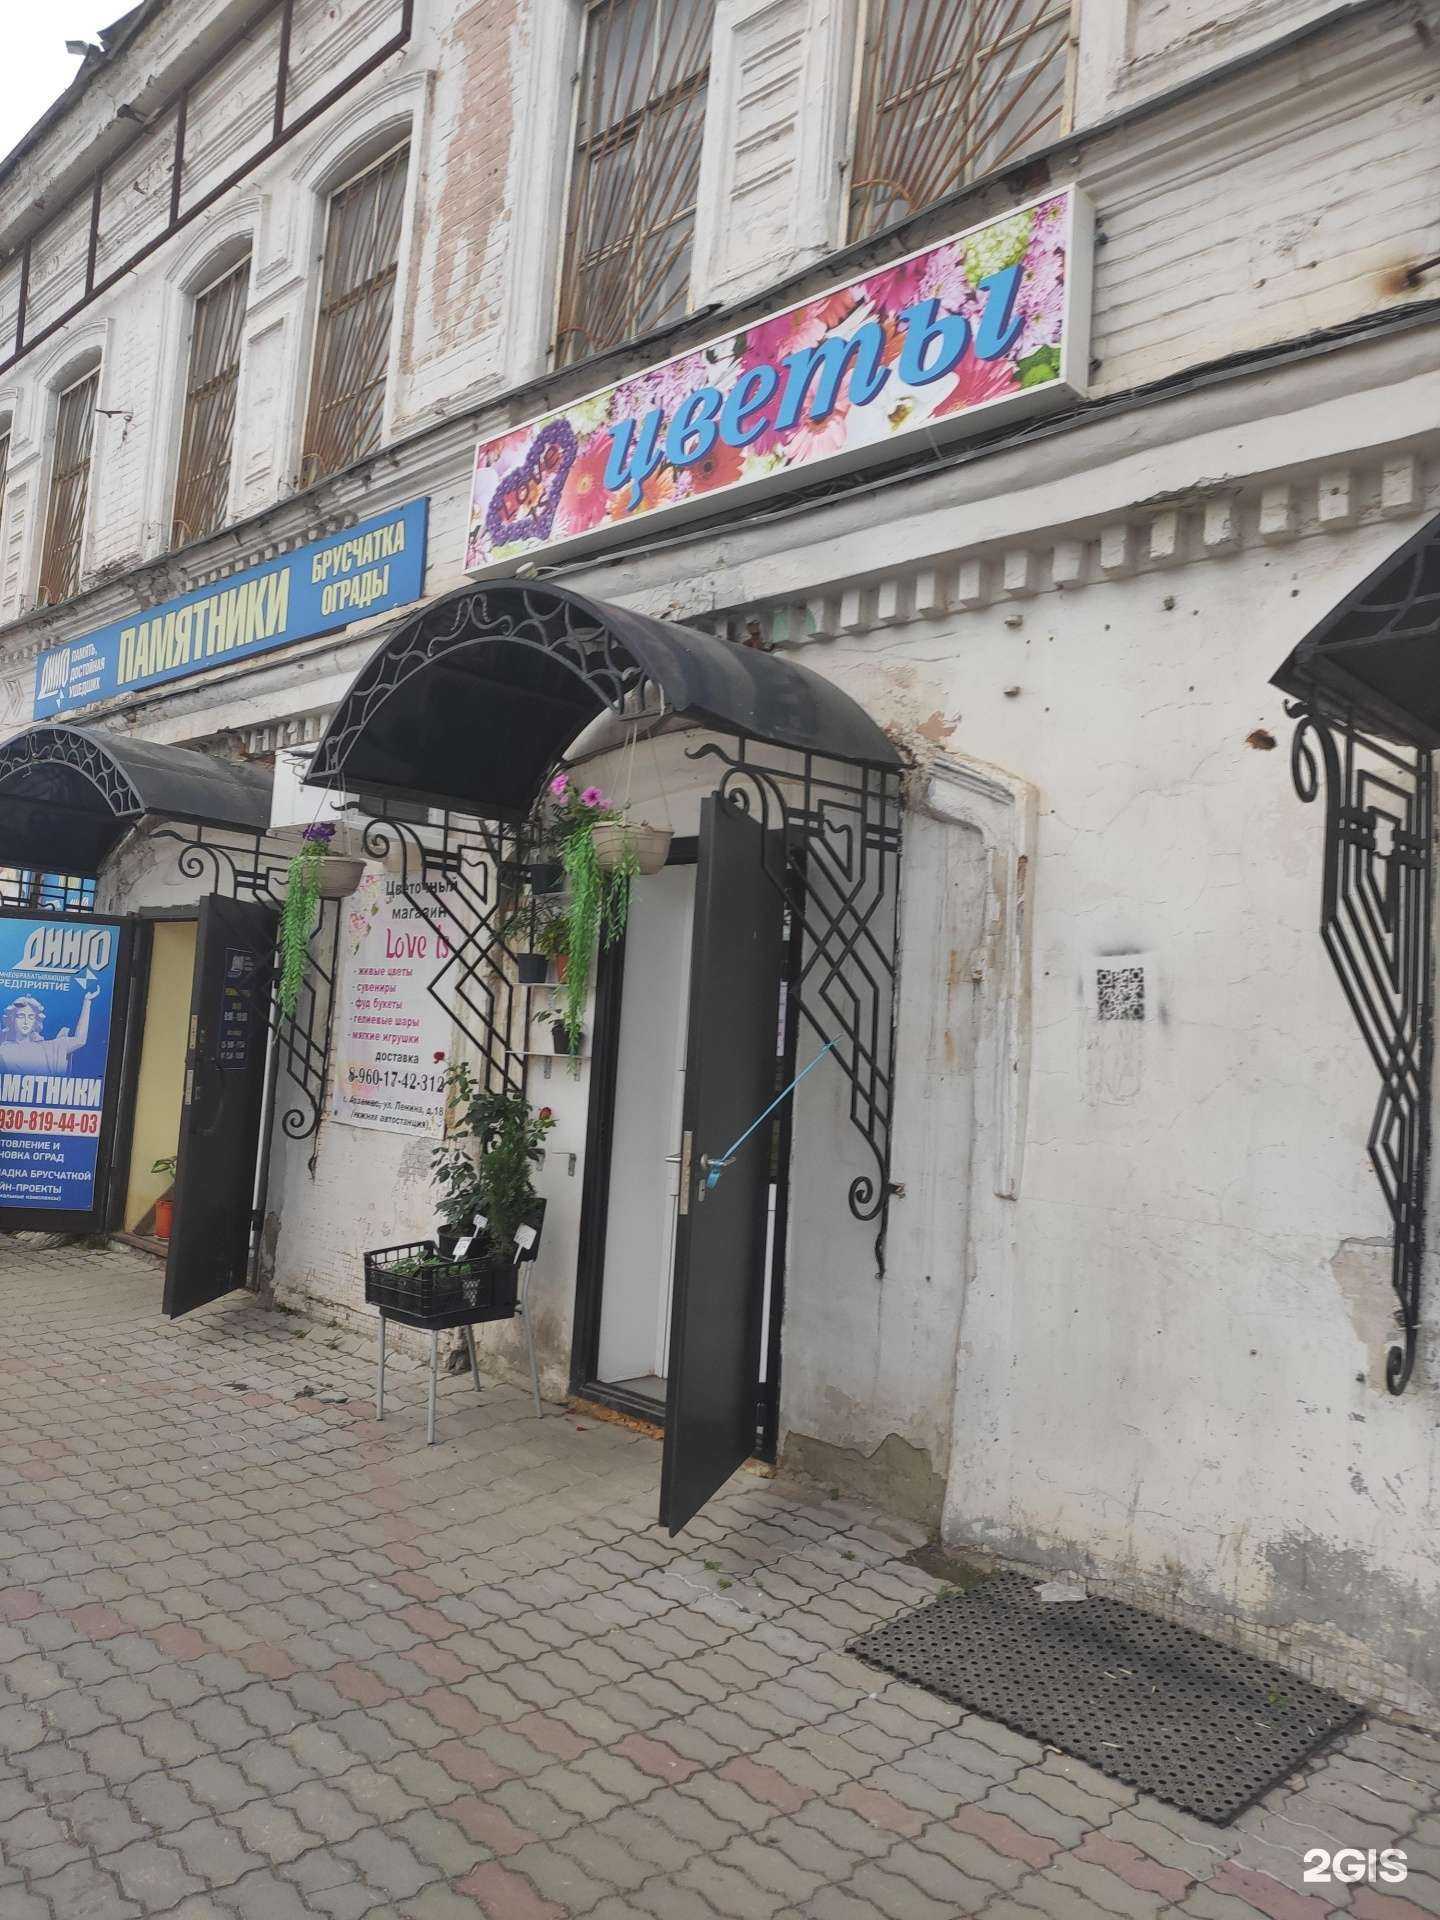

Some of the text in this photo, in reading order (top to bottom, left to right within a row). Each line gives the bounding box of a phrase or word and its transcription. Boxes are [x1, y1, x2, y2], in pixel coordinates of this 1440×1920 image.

[603, 264, 1026, 512] цветы
[311, 520, 405, 584] БРУСЧАТКА
[321, 563, 390, 615] ОГРАДЫ
[117, 567, 291, 685] ПАМЯТНИКИ
[392, 906, 447, 919] магазин
[386, 928, 427, 958] Love
[375, 1052, 419, 1064] доставка
[0, 1073, 101, 1107] МЯТНИКИ
[348, 1066, 445, 1093] 8-960-17-42-312
[33, 1152, 65, 1163] ОГРАД
[53, 1142, 61, 1150] И
[0, 1168, 91, 1180] АДКА БРУСЧАТКОЙ
